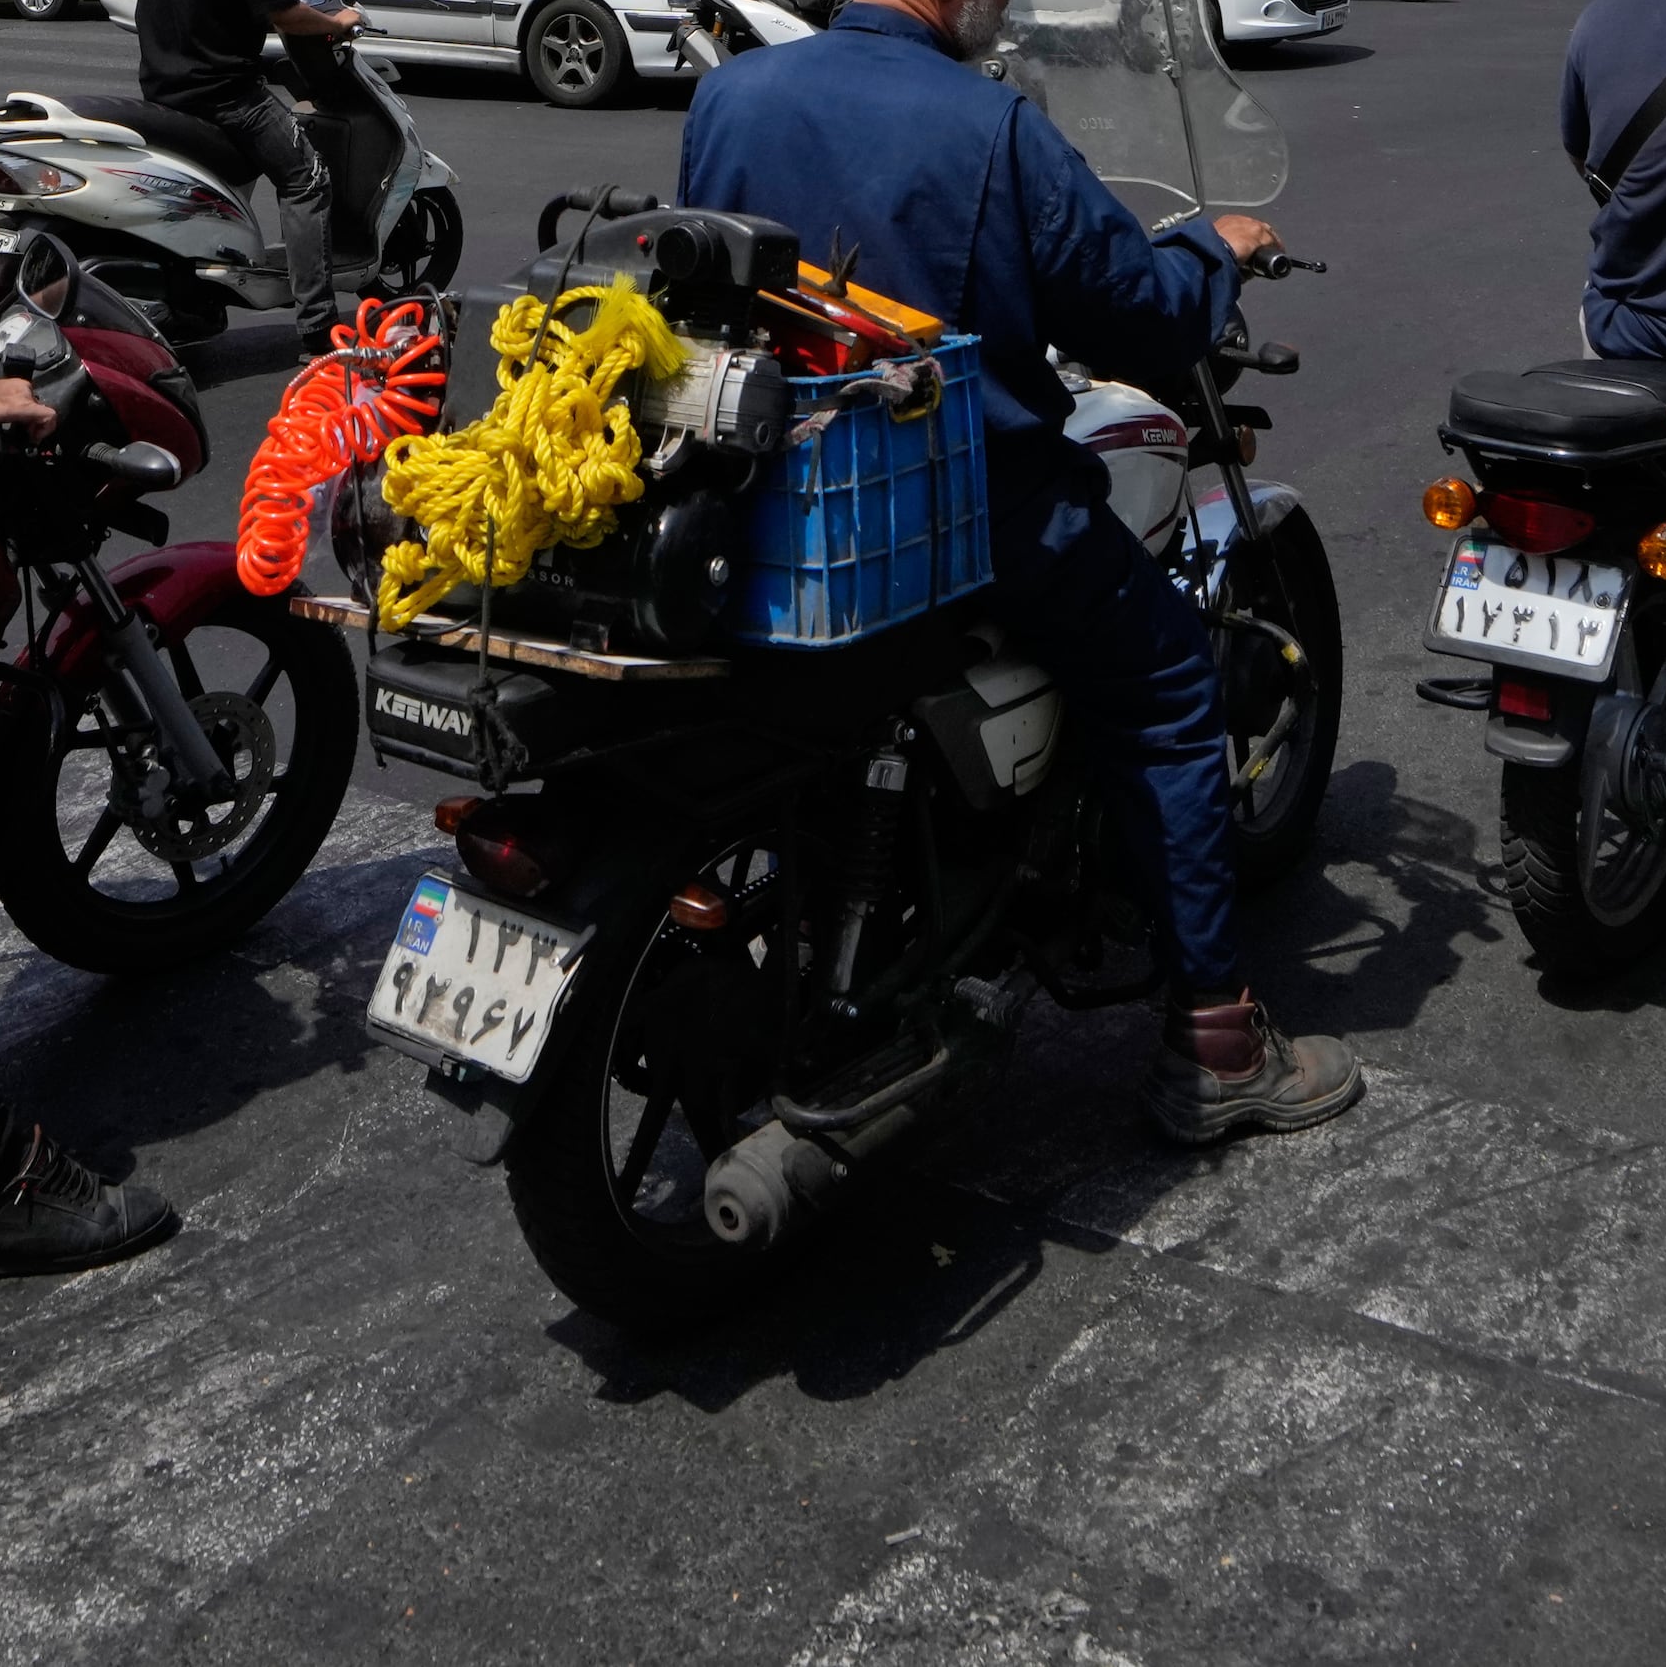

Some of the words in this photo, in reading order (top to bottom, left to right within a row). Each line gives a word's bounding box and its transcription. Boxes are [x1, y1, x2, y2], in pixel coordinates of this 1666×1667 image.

[1451, 576, 1479, 590] IRAN
[375, 687, 474, 737] KEEWAY
[466, 909, 559, 987] ۱۳۳
